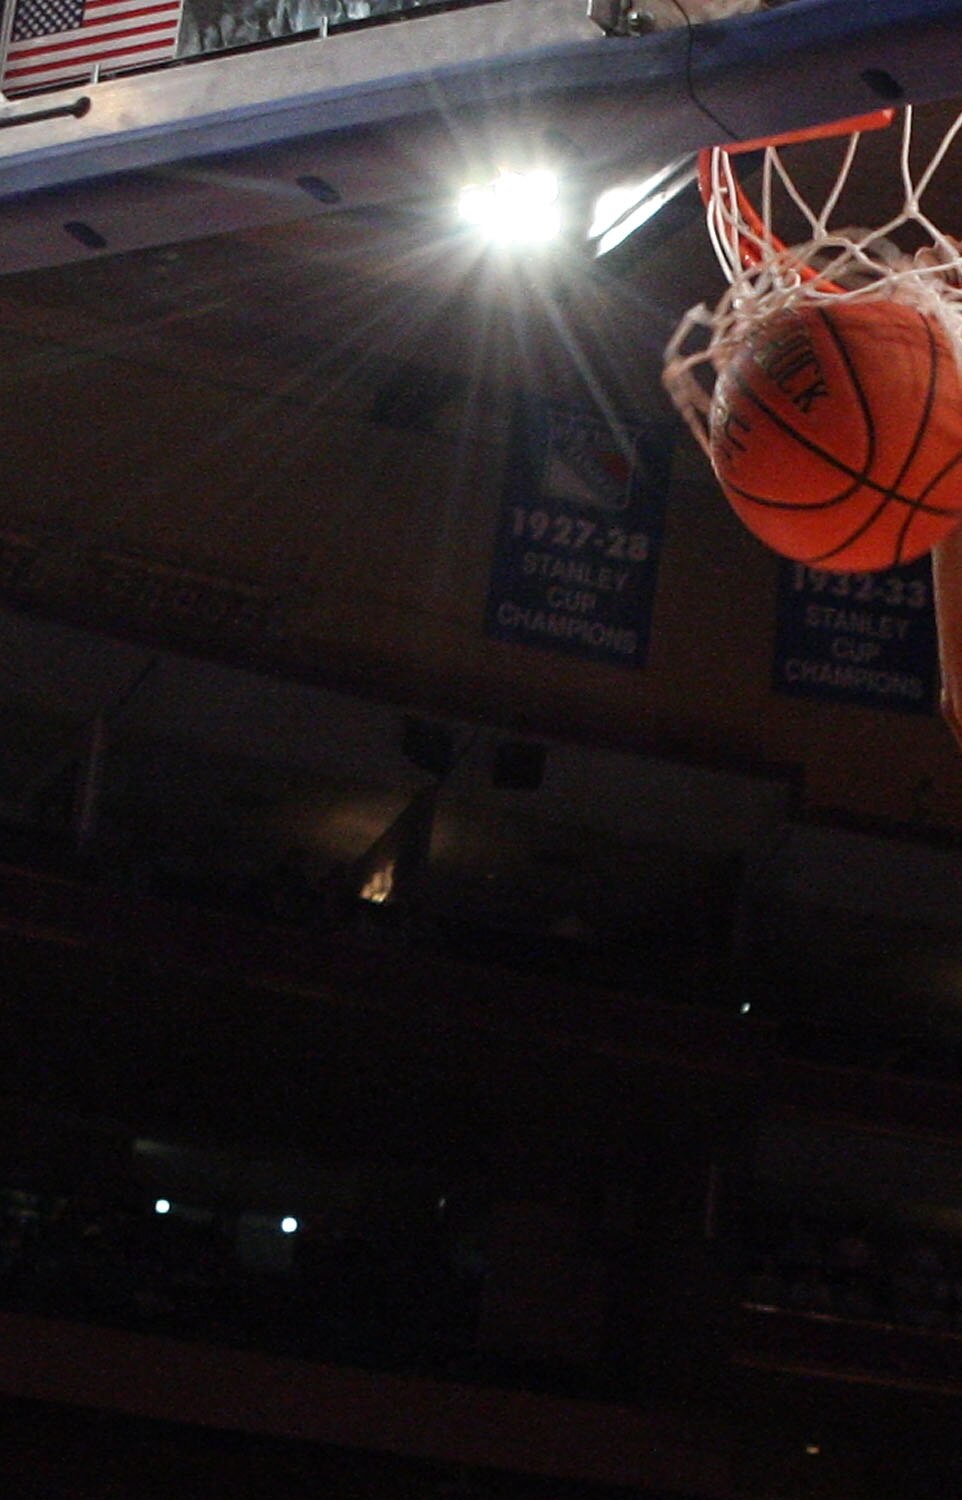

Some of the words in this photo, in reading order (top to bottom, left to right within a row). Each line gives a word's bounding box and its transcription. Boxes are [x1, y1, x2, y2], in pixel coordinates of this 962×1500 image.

[512, 506, 650, 561] 1927-28
[522, 551, 629, 592] STANLEY
[792, 566, 928, 608] 1932-33
[546, 584, 597, 613] CUP
[496, 602, 638, 654] CHAMPIONS
[805, 603, 912, 641] STANLEY
[831, 635, 882, 663] CUP
[784, 658, 925, 699] CHAMPIONS
